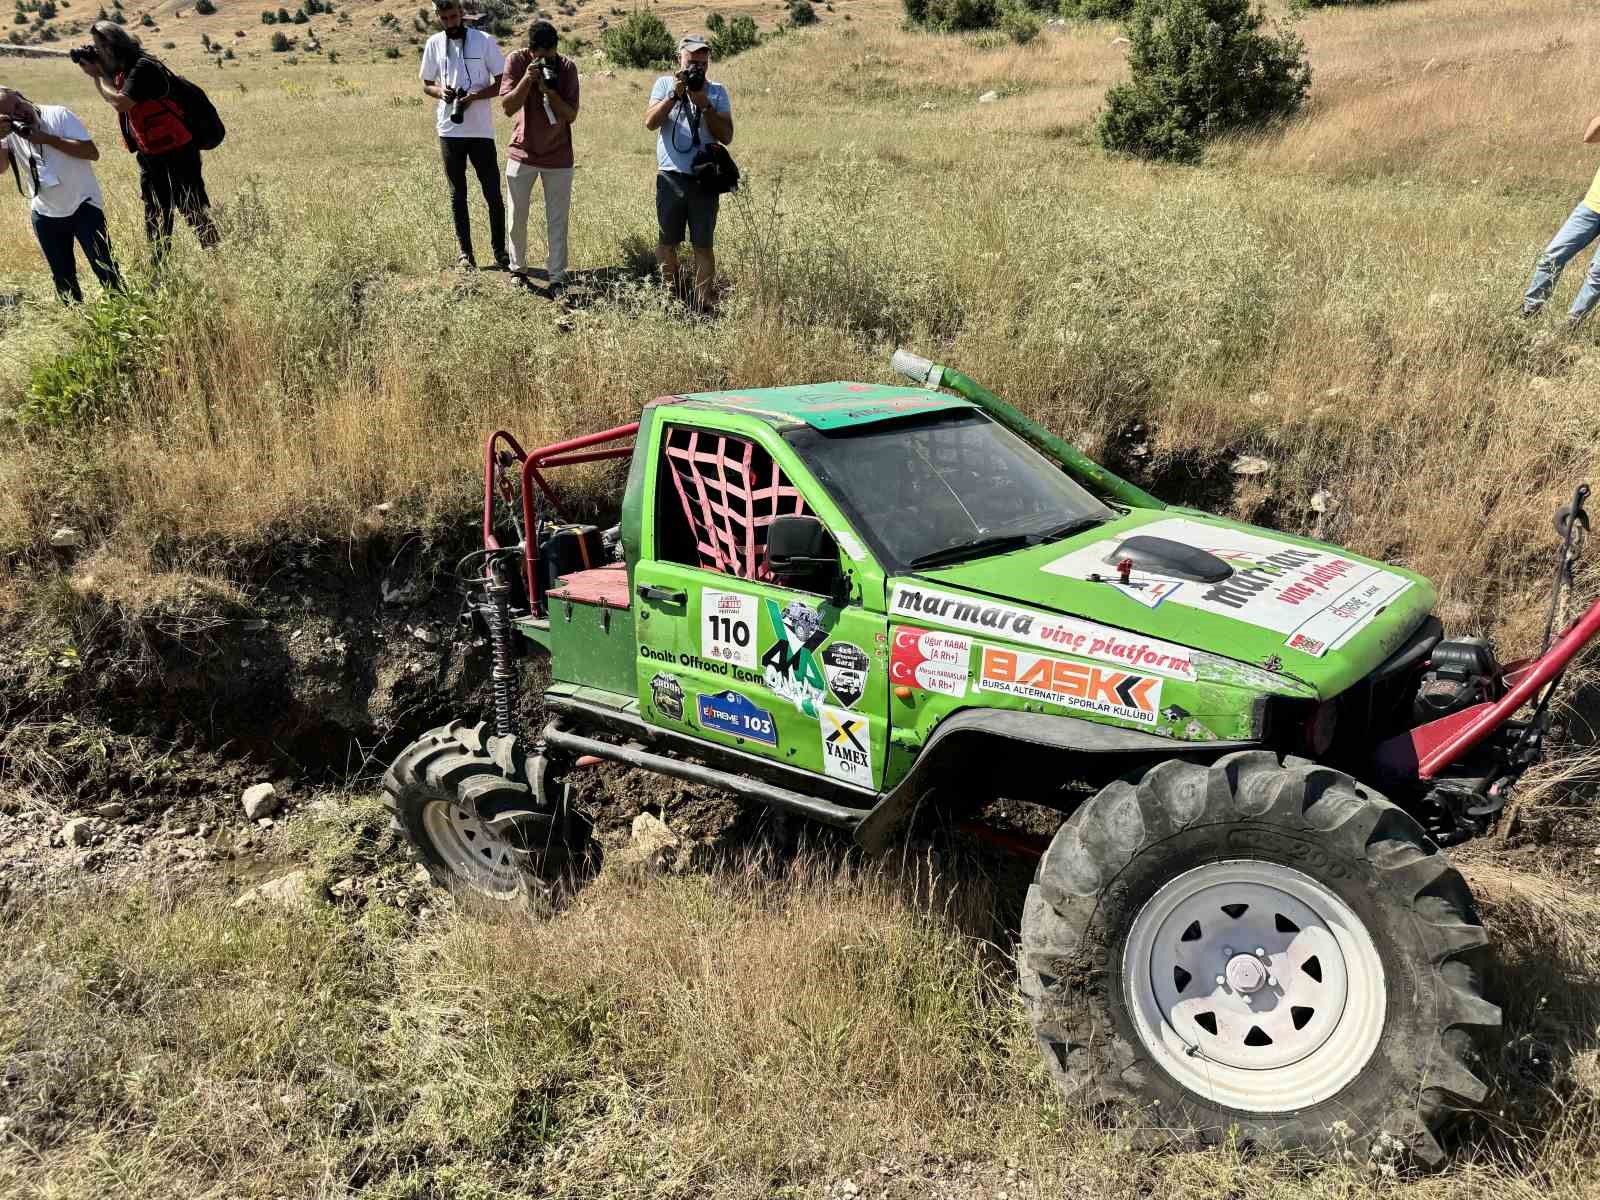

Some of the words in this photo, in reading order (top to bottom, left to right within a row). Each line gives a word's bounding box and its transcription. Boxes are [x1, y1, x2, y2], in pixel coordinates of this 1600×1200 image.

[709, 615, 750, 647] 110
[898, 589, 1033, 636] marmara
[1041, 624, 1086, 652] vinç
[1089, 638, 1190, 673] platform
[680, 653, 728, 677] Offroad
[731, 664, 765, 685] Team
[982, 679, 1011, 691] BURSA
[1013, 686, 1065, 704] ALTERNATİF
[1068, 696, 1110, 713] SPORLAR
[1113, 707, 1154, 722] KULÜBÜ
[743, 715, 770, 734] 103
[826, 743, 869, 768] YAMEX
[840, 761, 858, 776] Oil
